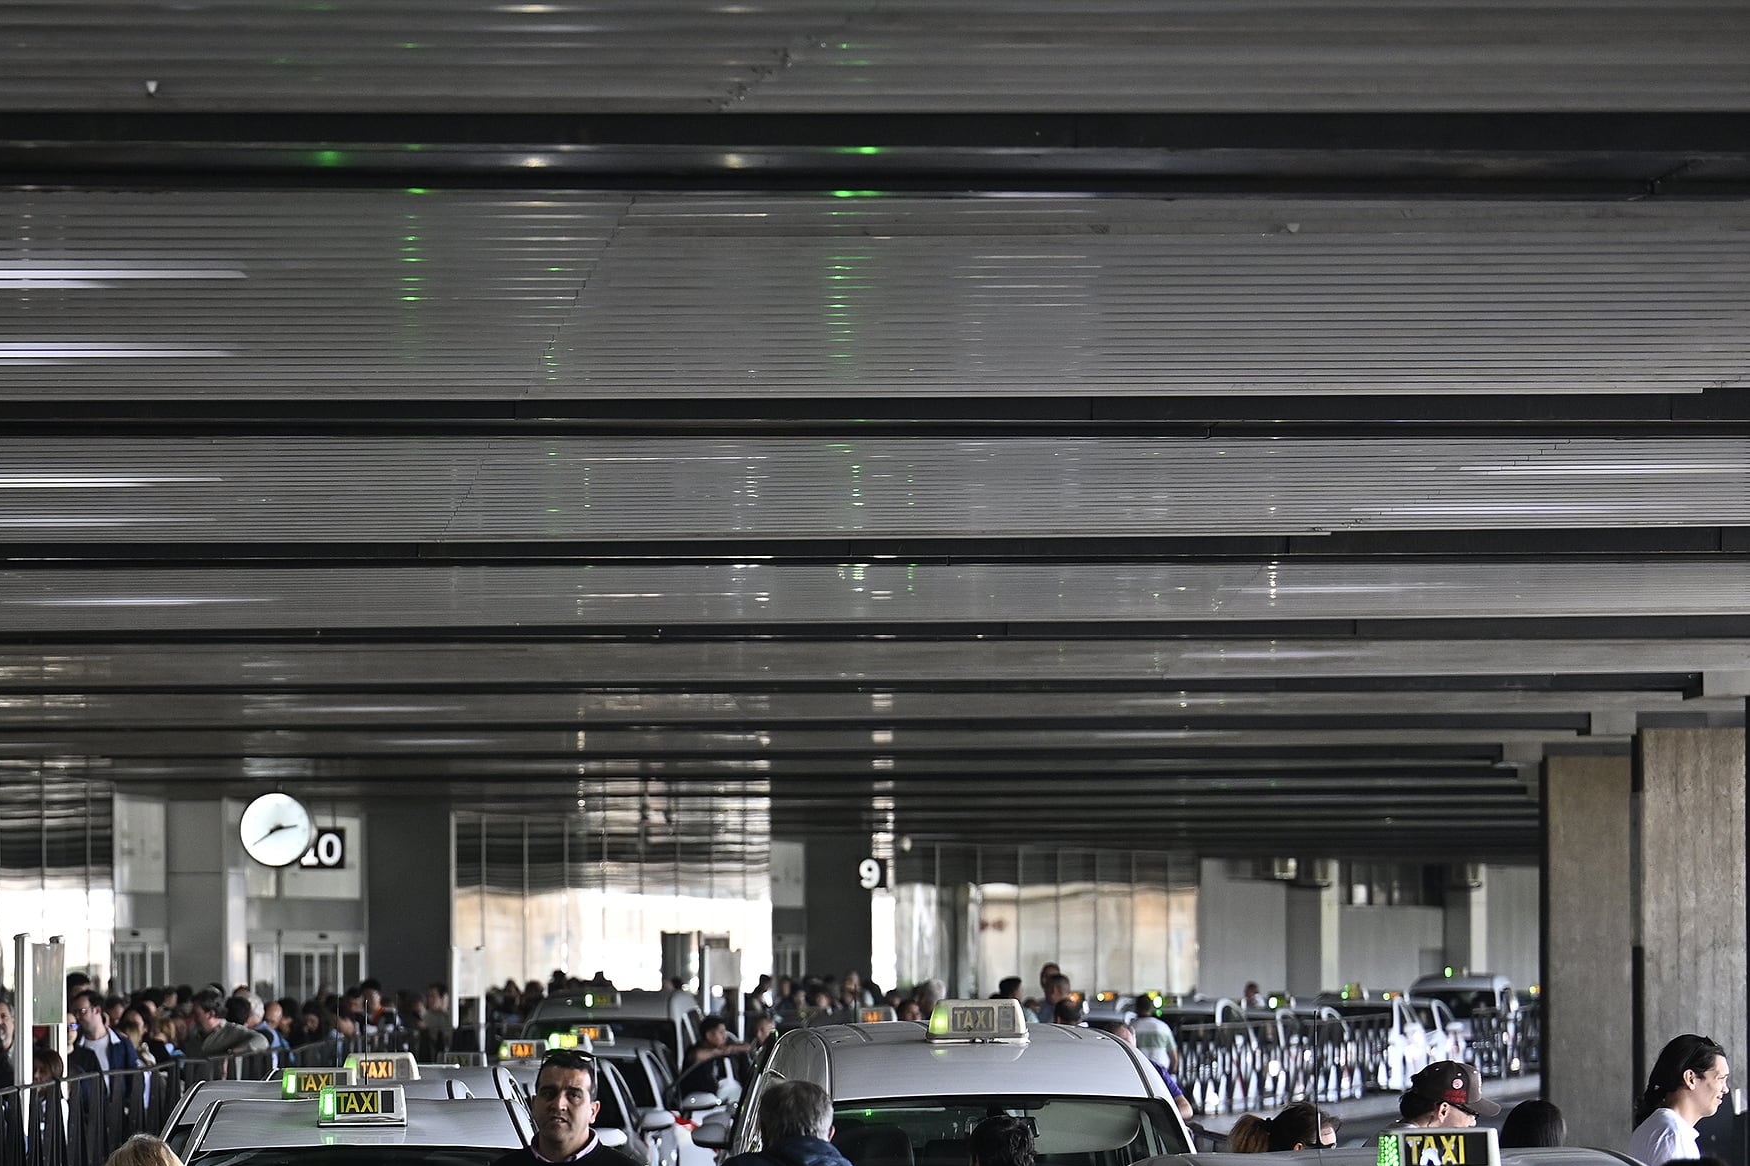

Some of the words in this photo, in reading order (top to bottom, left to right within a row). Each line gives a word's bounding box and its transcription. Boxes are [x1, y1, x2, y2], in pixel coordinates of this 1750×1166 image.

[858, 858, 881, 889] 9
[954, 1009, 993, 1030] TAXI
[360, 1061, 393, 1079] TAXI
[299, 1074, 334, 1093] TAXI
[336, 1091, 379, 1114] TAXI
[1405, 1134, 1466, 1166] TAXI
